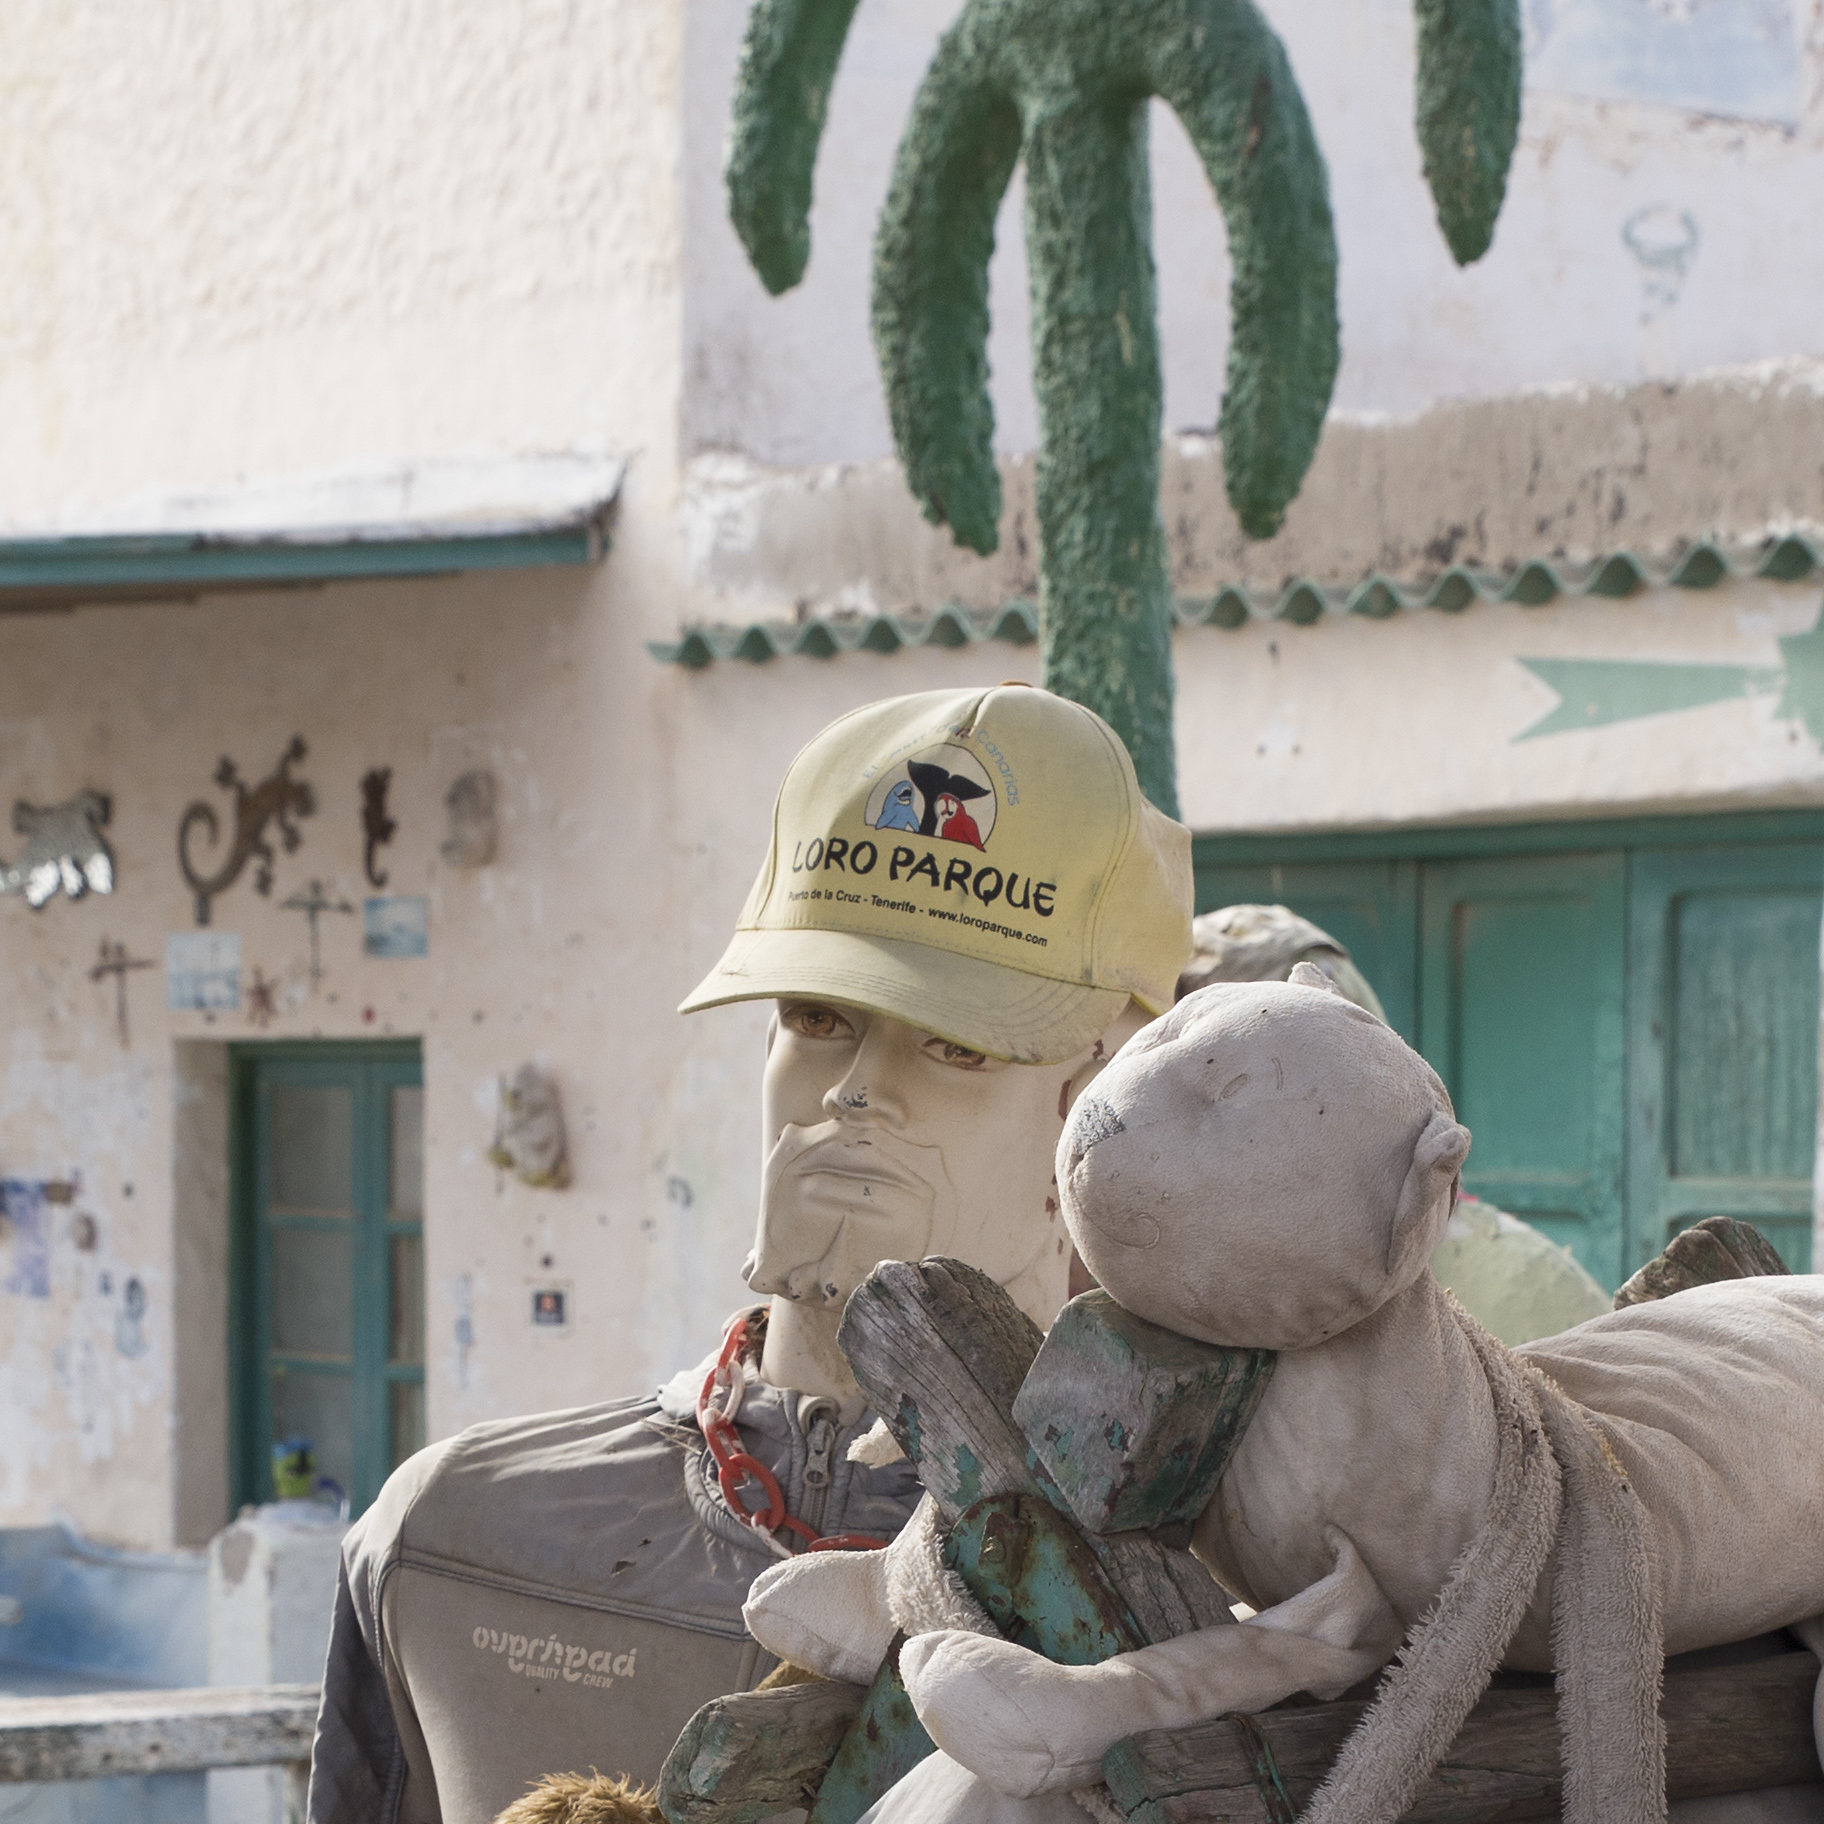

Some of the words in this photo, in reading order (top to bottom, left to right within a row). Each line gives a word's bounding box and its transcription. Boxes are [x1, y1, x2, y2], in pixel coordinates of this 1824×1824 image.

[792, 837, 878, 874] LORO
[889, 846, 1057, 917] PARQUE
[811, 889, 822, 899] de
[824, 889, 833, 900] la
[836, 890, 861, 903] Cruz
[871, 894, 916, 914] Tenerife
[928, 908, 1048, 947] www.loroparque.com
[583, 1674, 614, 1688] CREW
